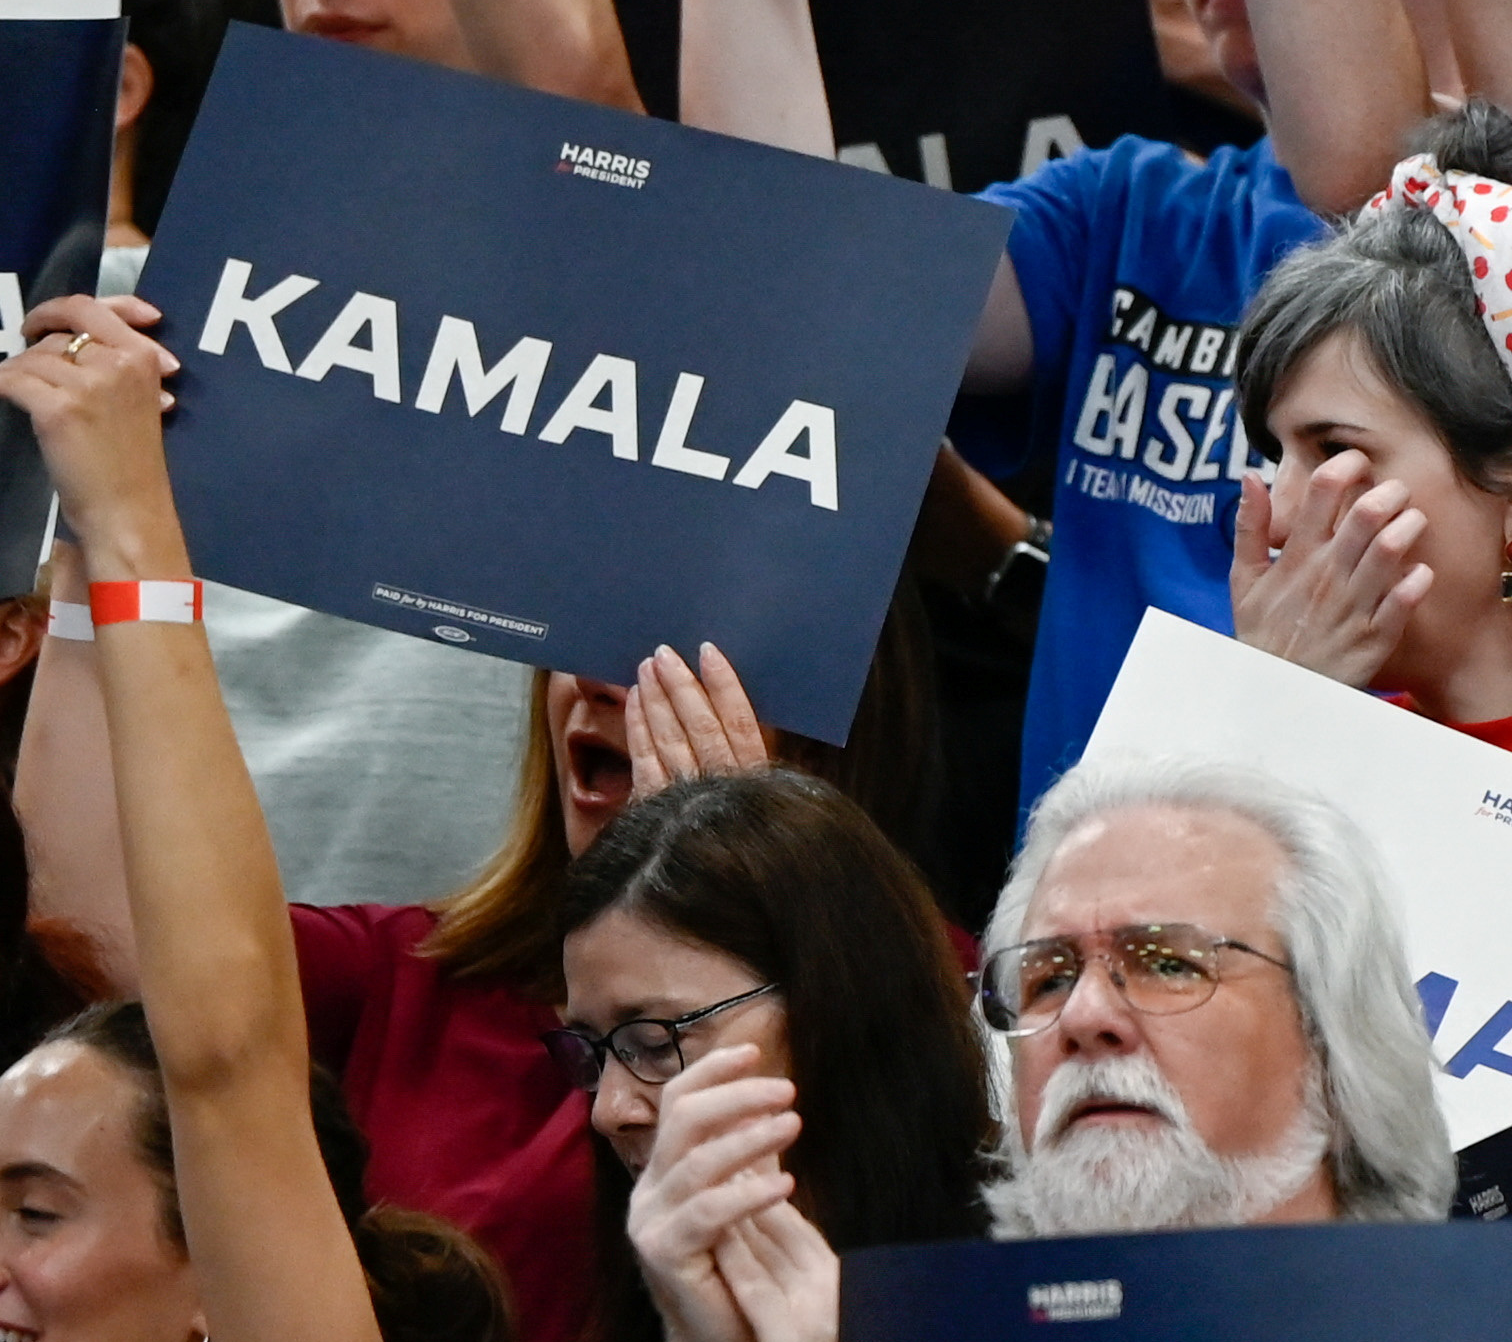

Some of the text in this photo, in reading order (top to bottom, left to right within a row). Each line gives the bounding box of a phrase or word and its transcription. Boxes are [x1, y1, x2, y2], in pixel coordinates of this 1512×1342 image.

[560, 141, 652, 180] HARRIS
[572, 164, 647, 190] PRESIDENT
[197, 257, 839, 511] KAMALA
[1128, 473, 1216, 524] MISSION
[375, 587, 401, 601] PAID
[427, 599, 466, 618] HARRIS
[467, 610, 488, 623] FOR
[488, 616, 545, 637] PRESIDENT
